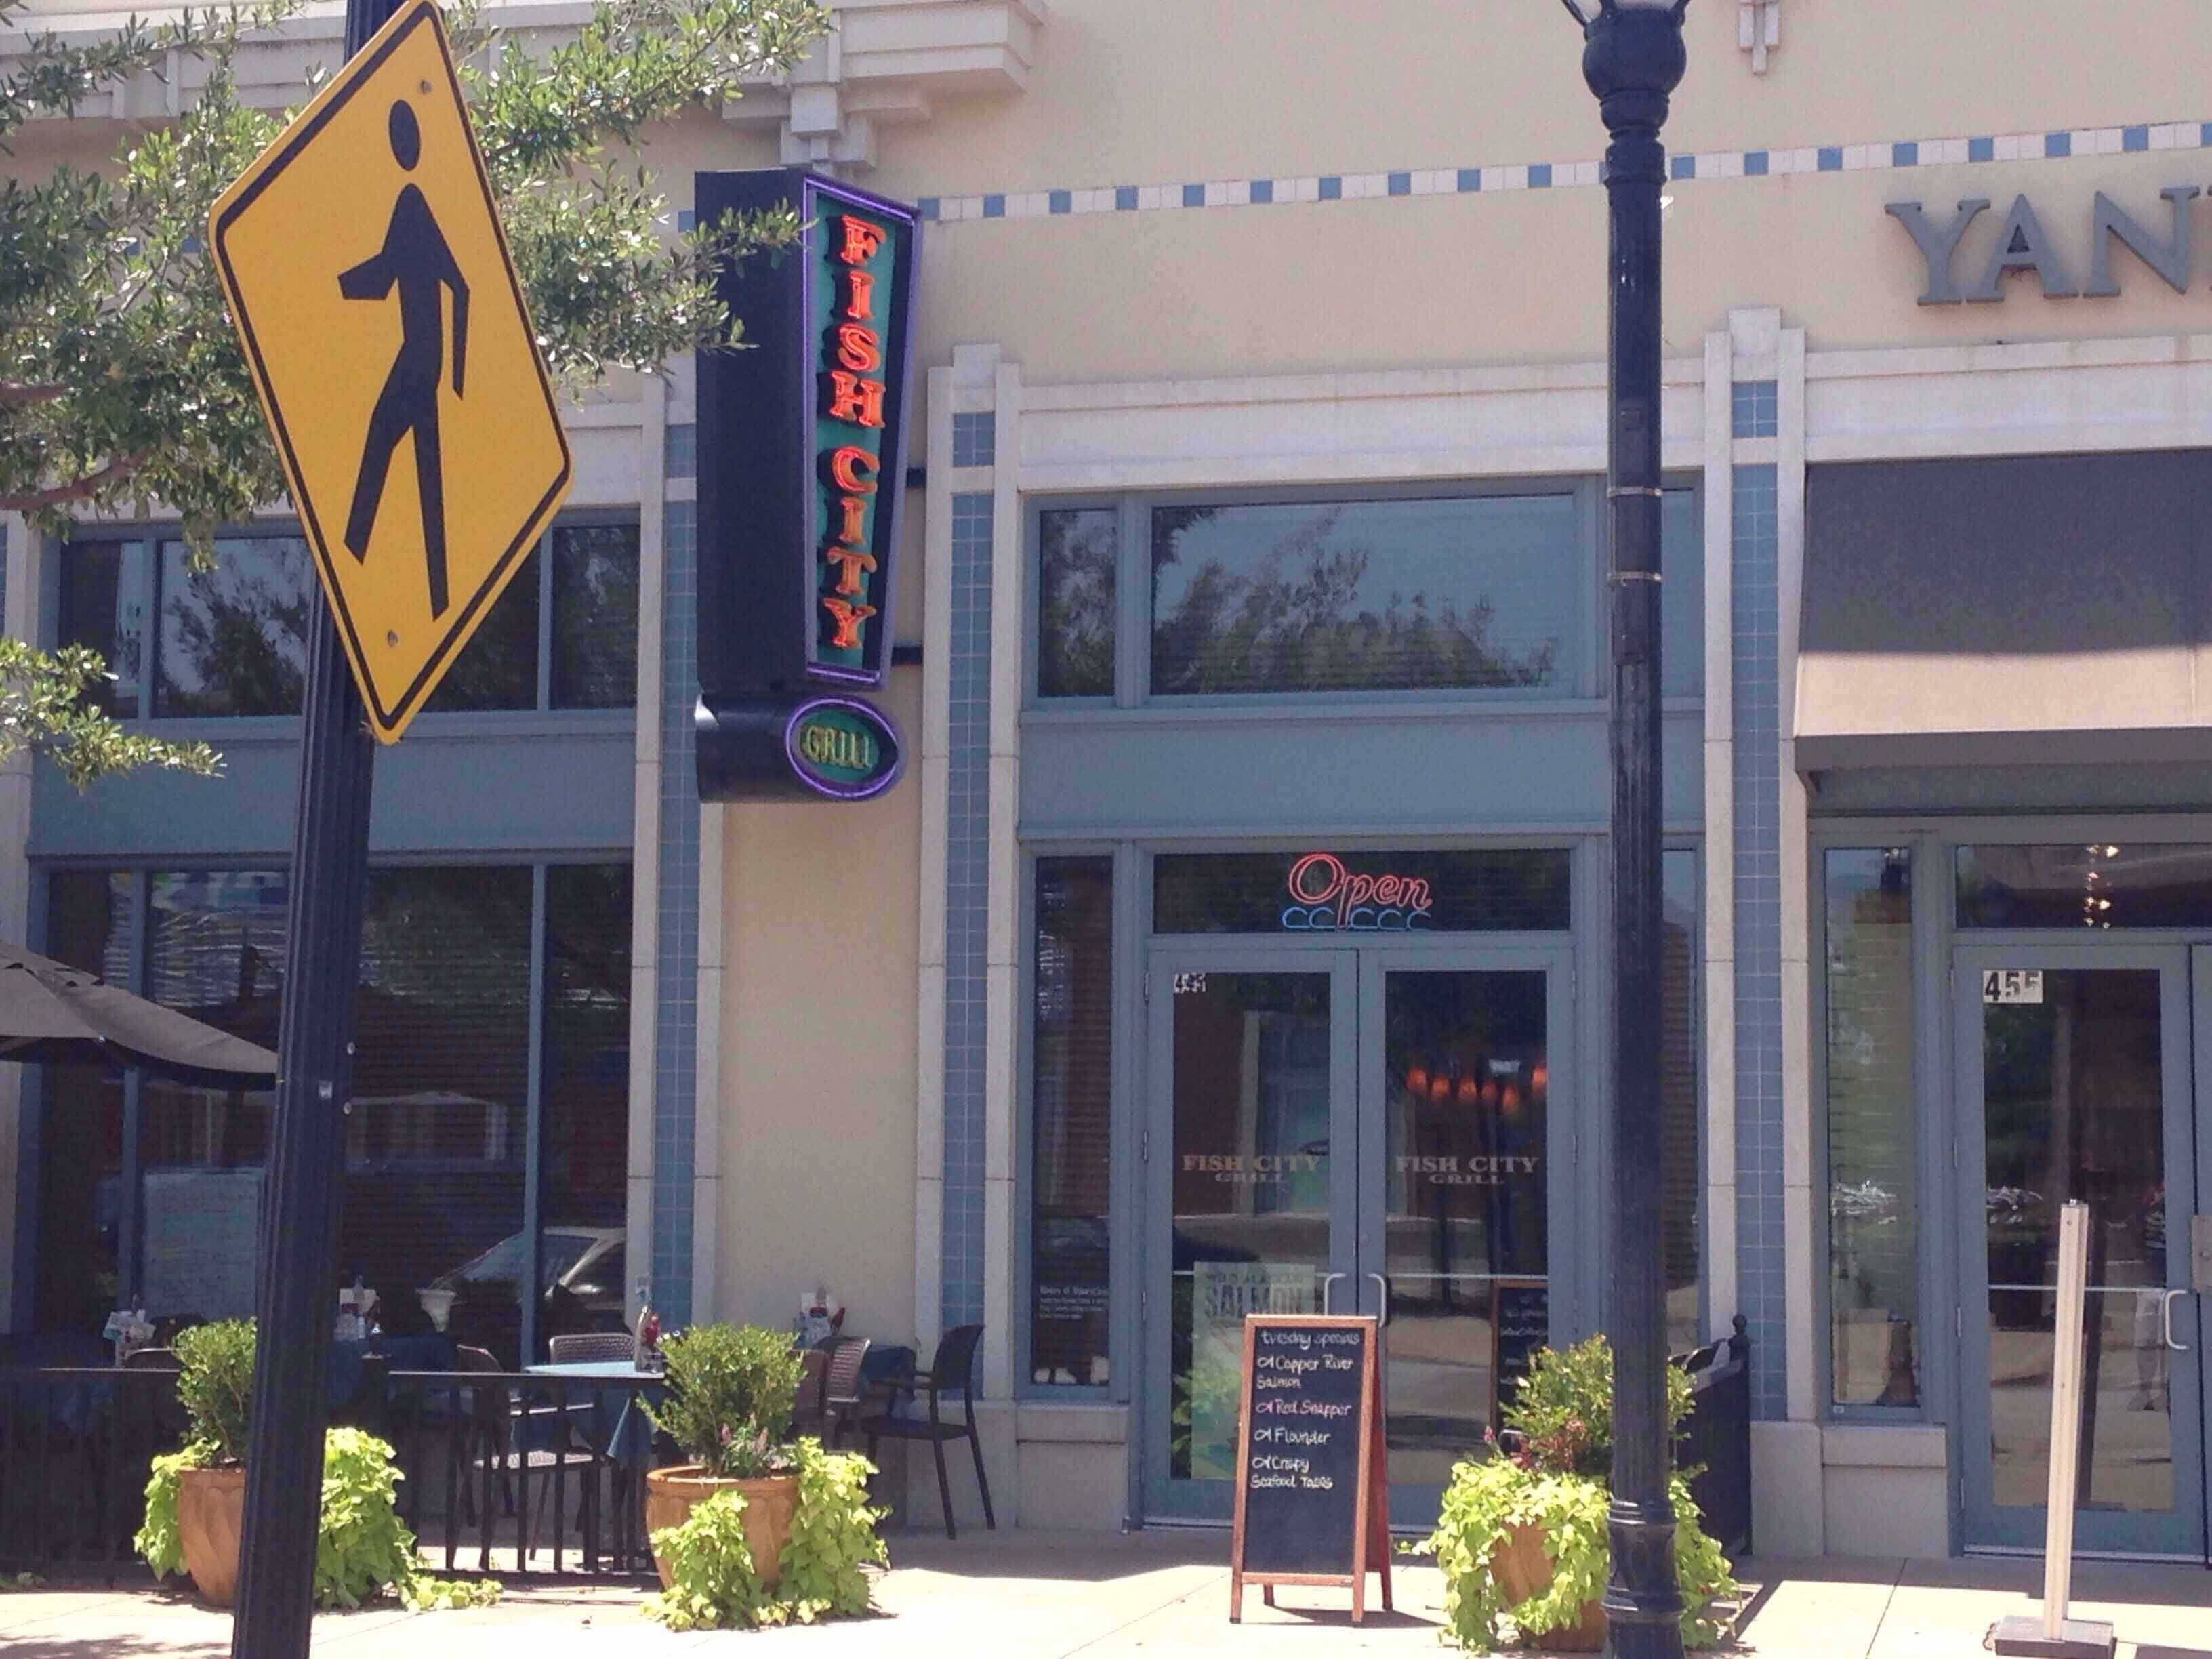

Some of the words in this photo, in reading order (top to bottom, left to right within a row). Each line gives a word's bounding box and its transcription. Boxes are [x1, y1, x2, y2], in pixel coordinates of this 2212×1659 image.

[1884, 185, 2212, 306] YAN
[830, 215, 886, 428] FISH
[822, 445, 880, 649] CITY
[798, 724, 870, 769] GRILL
[1288, 852, 1433, 928] Open
[1182, 1155, 1244, 1172] FISH
[1254, 1155, 1319, 1172] CITY
[1395, 1155, 1458, 1172] FISH
[1469, 1156, 1539, 1174] CITY
[1429, 1174, 1504, 1185] GRILL
[1275, 1355, 1319, 1375] Copper
[1322, 1353, 1354, 1370] River
[1256, 1374, 1302, 1389] Salmon
[1275, 1398, 1298, 1415] Red
[1300, 1399, 1353, 1420] Snapper
[1275, 1427, 1331, 1446] Flounder
[1271, 1455, 1310, 1473] Crispy
[1250, 1473, 1297, 1489] Seafood
